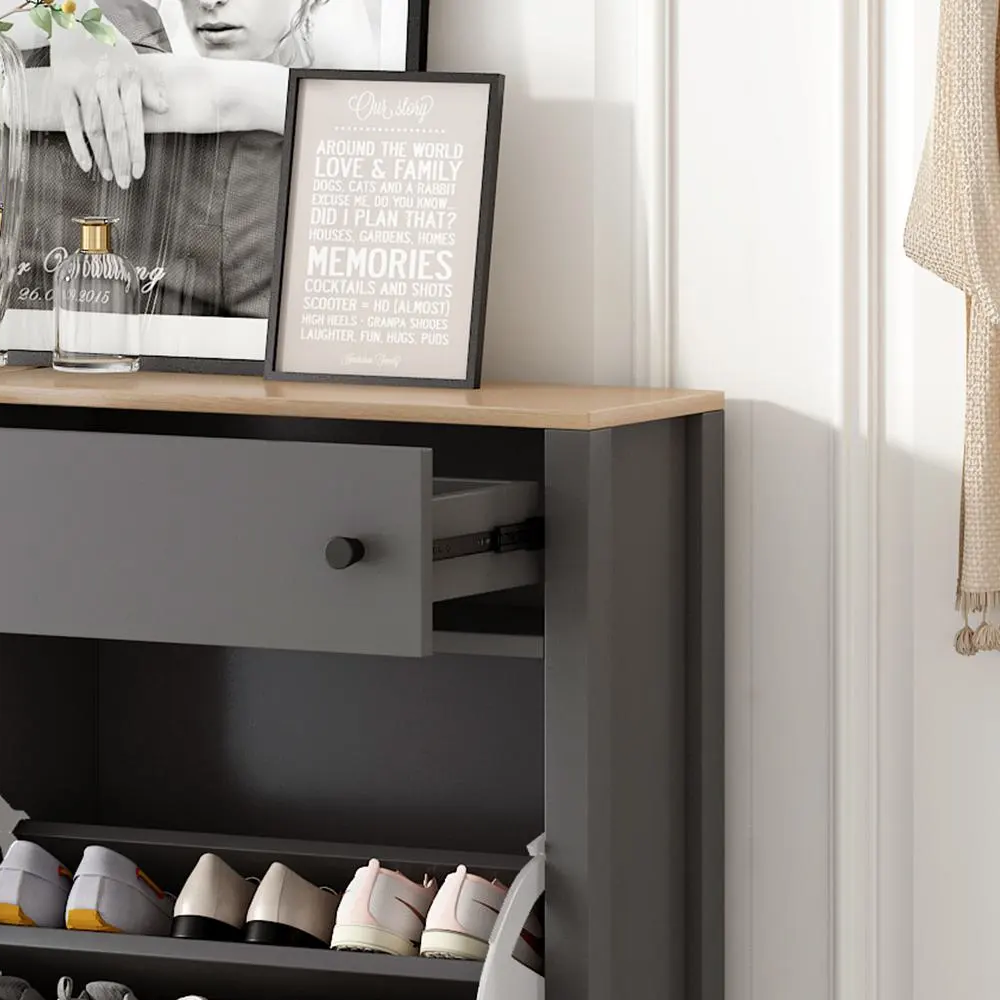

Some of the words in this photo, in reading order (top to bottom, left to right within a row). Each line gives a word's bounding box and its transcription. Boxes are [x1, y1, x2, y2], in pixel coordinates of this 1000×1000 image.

[394, 95, 434, 123] story
[316, 139, 375, 156] AROUND
[381, 141, 407, 158] THE
[413, 142, 464, 159] WORLD
[315, 157, 364, 179] LOVE
[371, 159, 386, 180] &
[394, 159, 464, 182] FAMILY
[349, 180, 376, 194] CATS
[379, 181, 402, 194] AND
[405, 182, 414, 195] A
[417, 182, 456, 196] RABBIT
[312, 194, 351, 207] EXCUSE
[374, 195, 389, 208] DO
[394, 196, 414, 209] YOU
[310, 207, 337, 226] DID
[343, 209, 348, 226] I
[354, 209, 398, 228] PLAN
[405, 210, 457, 230] THAT?
[418, 231, 456, 246] HOMES
[306, 246, 453, 281] MEMORIES
[304, 279, 376, 295] COCKTAILS
[380, 281, 407, 296] AND
[412, 282, 453, 298] SHOTS
[303, 297, 357, 312] SCOOTER
[394, 301, 450, 316] (ALMOST)
[301, 313, 324, 326] HIGH
[326, 314, 358, 327] HEELS
